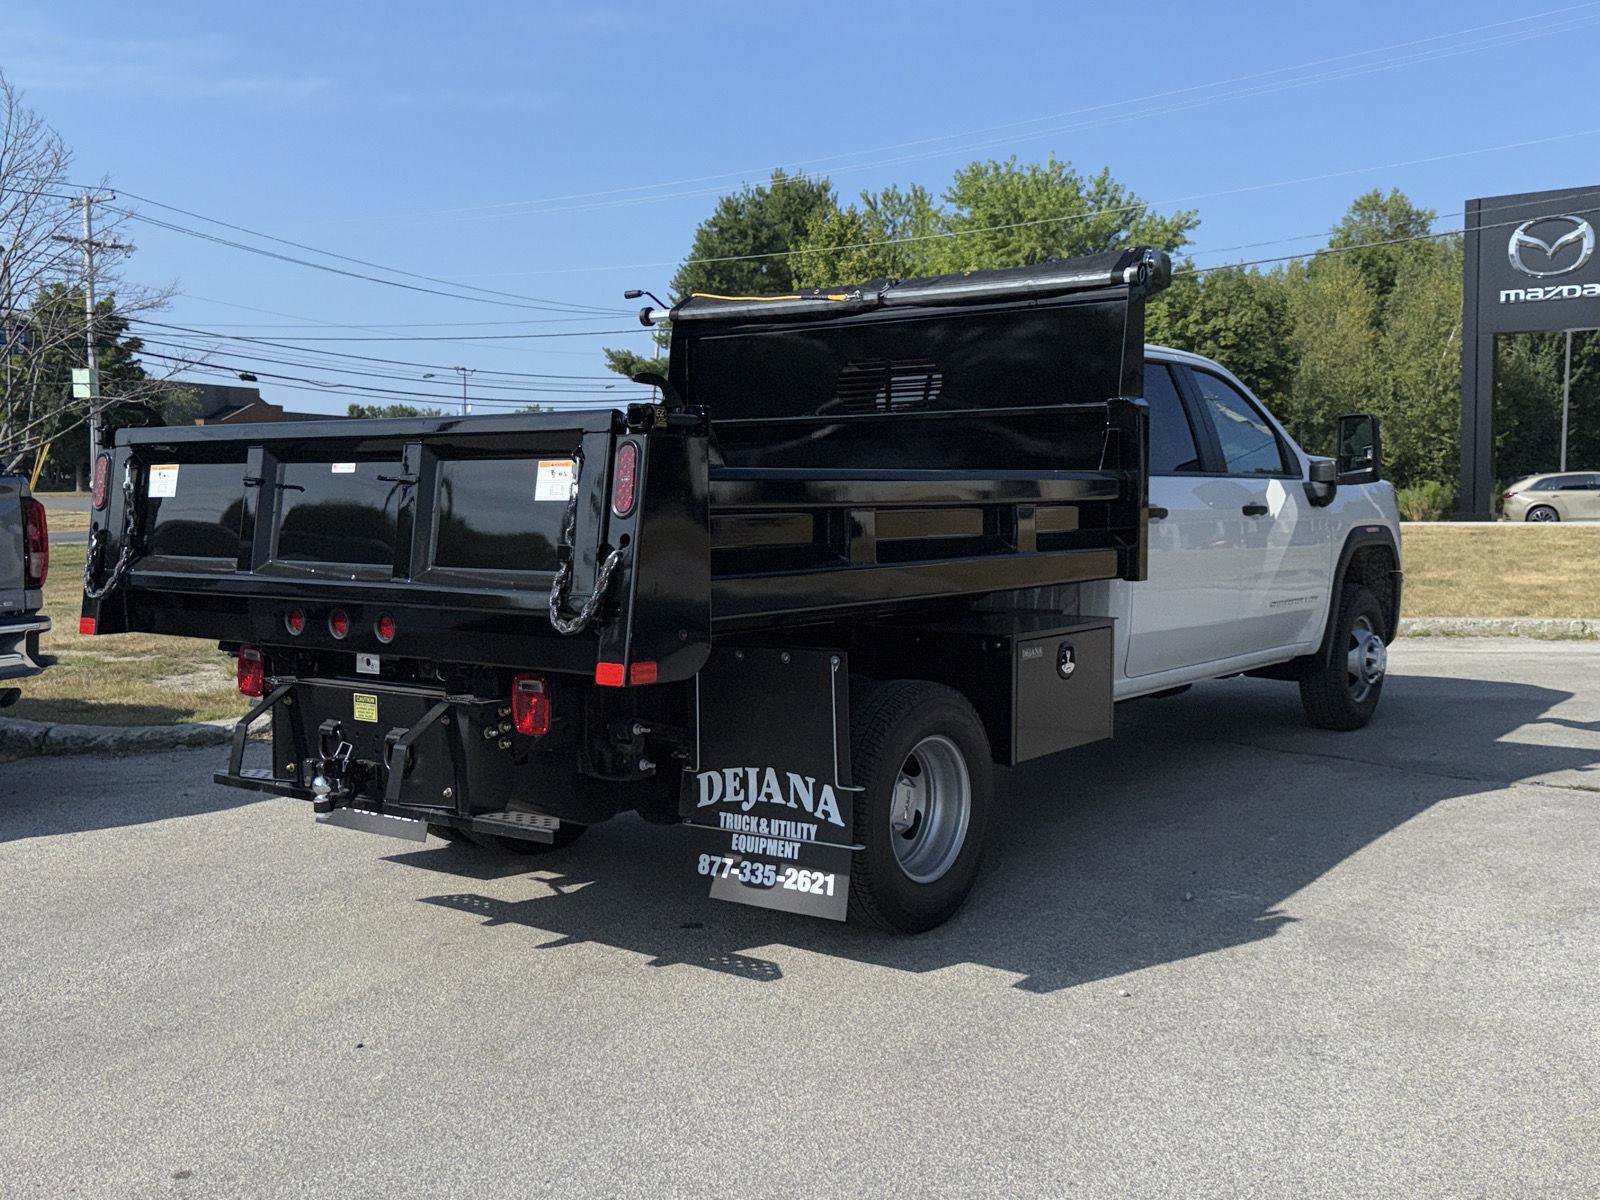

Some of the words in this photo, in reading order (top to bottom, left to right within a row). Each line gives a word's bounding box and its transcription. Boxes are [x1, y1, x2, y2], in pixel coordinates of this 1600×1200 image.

[696, 767, 846, 827] DEJANA
[730, 834, 802, 860] EQUIPMENT
[697, 853, 836, 897] 877-335-2621
